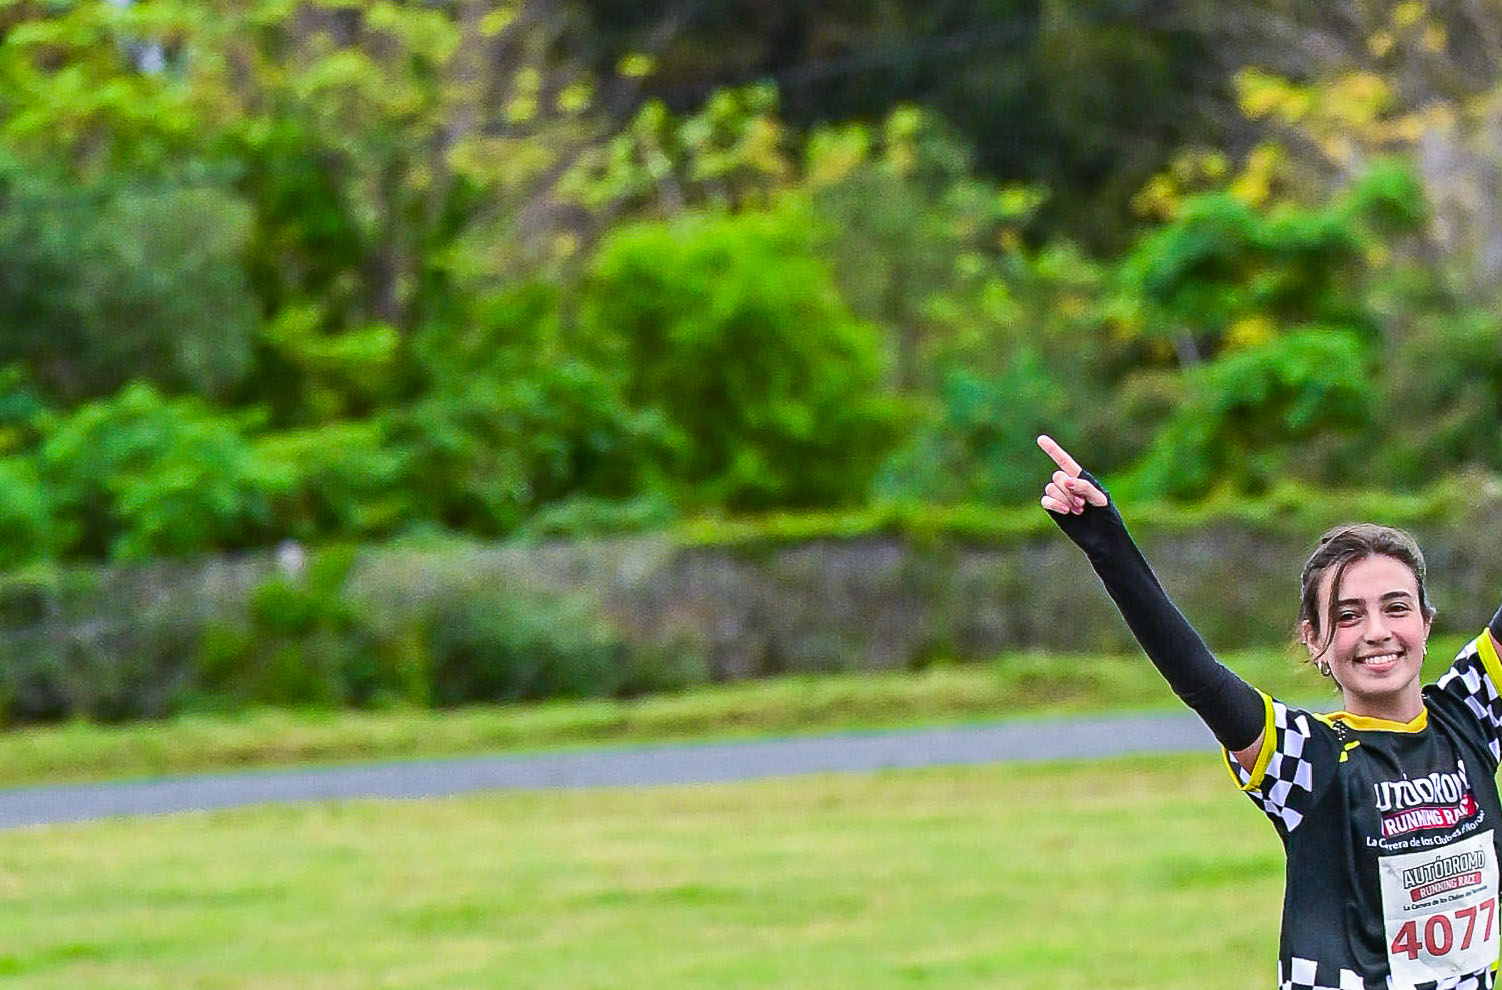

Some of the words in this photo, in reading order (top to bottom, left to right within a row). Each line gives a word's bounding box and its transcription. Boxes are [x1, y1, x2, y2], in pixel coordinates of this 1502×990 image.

[1384, 809, 1444, 836] RUNNING
[1442, 797, 1469, 825] RAC
[1366, 836, 1378, 847] La
[1409, 836, 1421, 847] de
[1402, 850, 1486, 889] AUTÓDROMO
[1420, 878, 1458, 898] RUNNING
[1458, 874, 1476, 887] RACE
[1391, 897, 1496, 961] 4077
